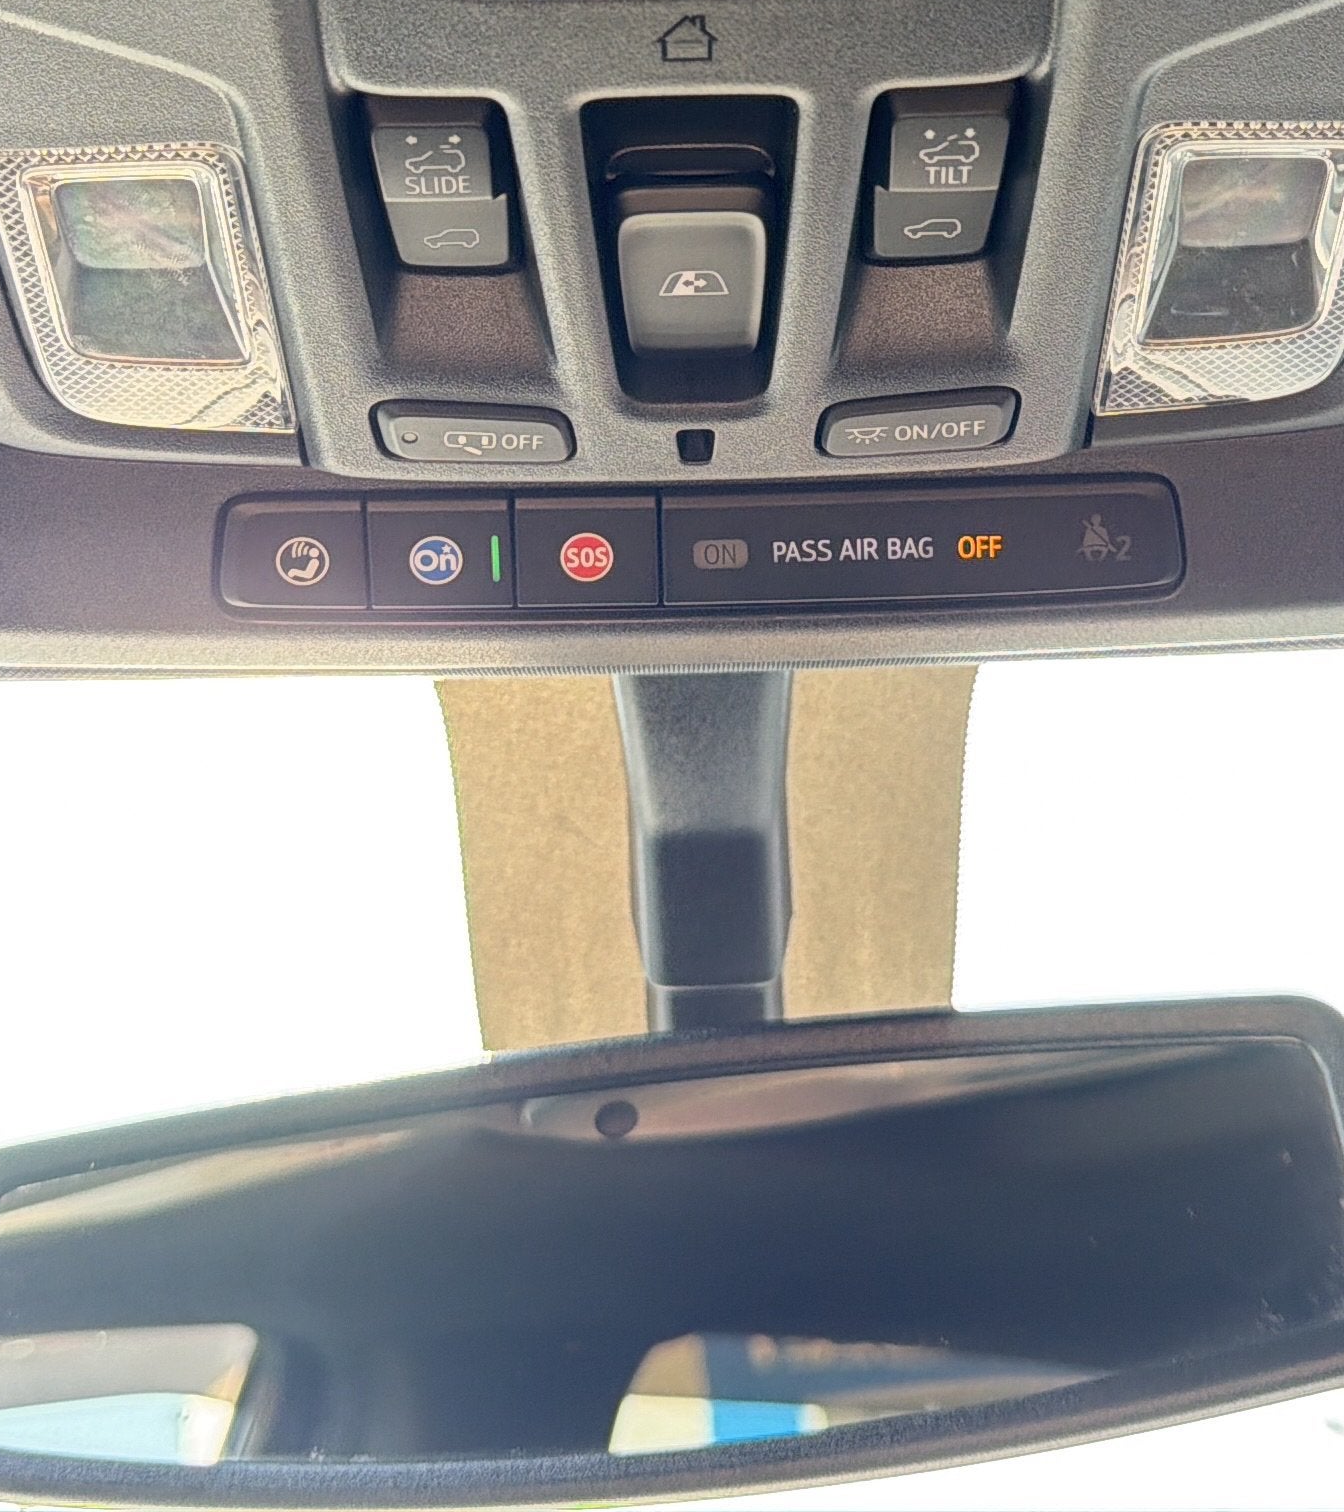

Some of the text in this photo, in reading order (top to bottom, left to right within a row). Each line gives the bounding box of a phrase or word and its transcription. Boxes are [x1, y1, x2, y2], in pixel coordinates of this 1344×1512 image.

[404, 175, 472, 195] SLIDE
[924, 165, 974, 185] TILT
[894, 419, 986, 442] ON/OFF
[501, 433, 544, 451] OFF
[565, 546, 608, 569] SOS
[703, 534, 1004, 566] ON PASS AIR BAG OFF
